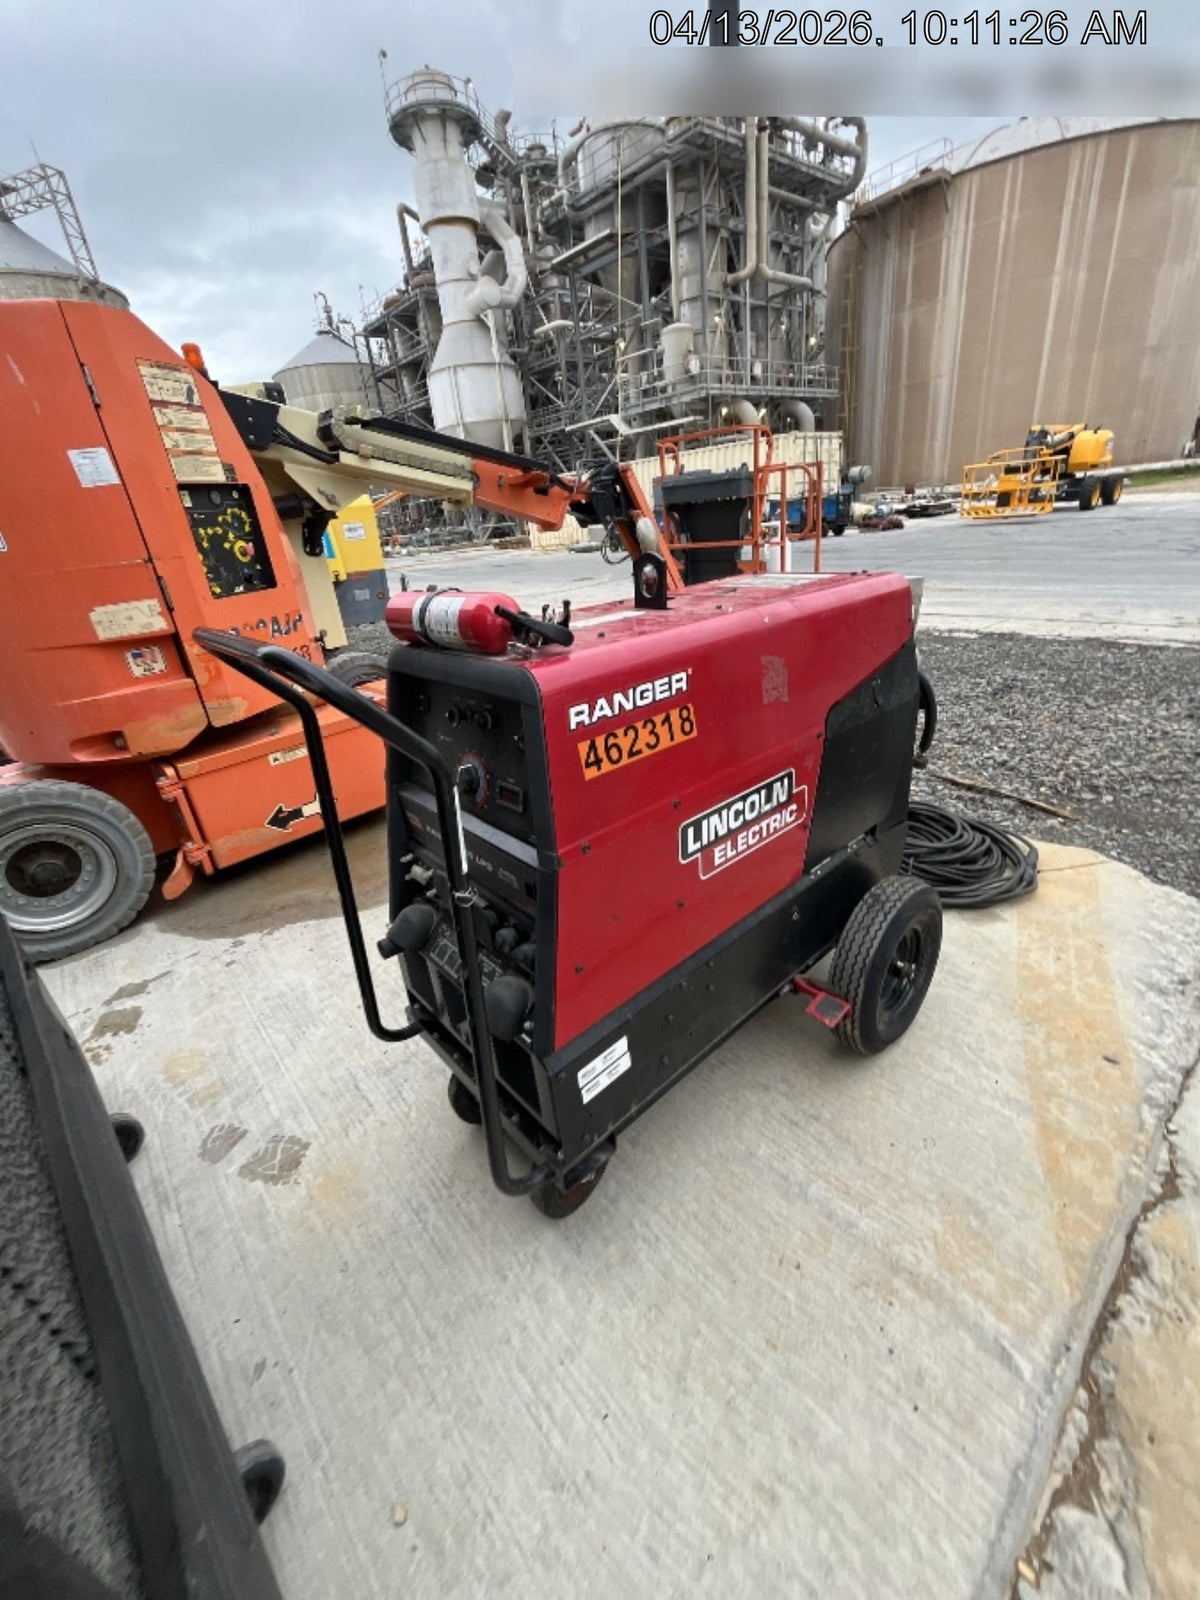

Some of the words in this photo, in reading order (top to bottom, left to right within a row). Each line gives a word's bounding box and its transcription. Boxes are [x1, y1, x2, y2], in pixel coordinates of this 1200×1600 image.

[568, 670, 689, 731] RANGER
[584, 705, 695, 772] 462318
[687, 776, 790, 855] LINCOLN
[713, 802, 798, 867] ELECTRIC
